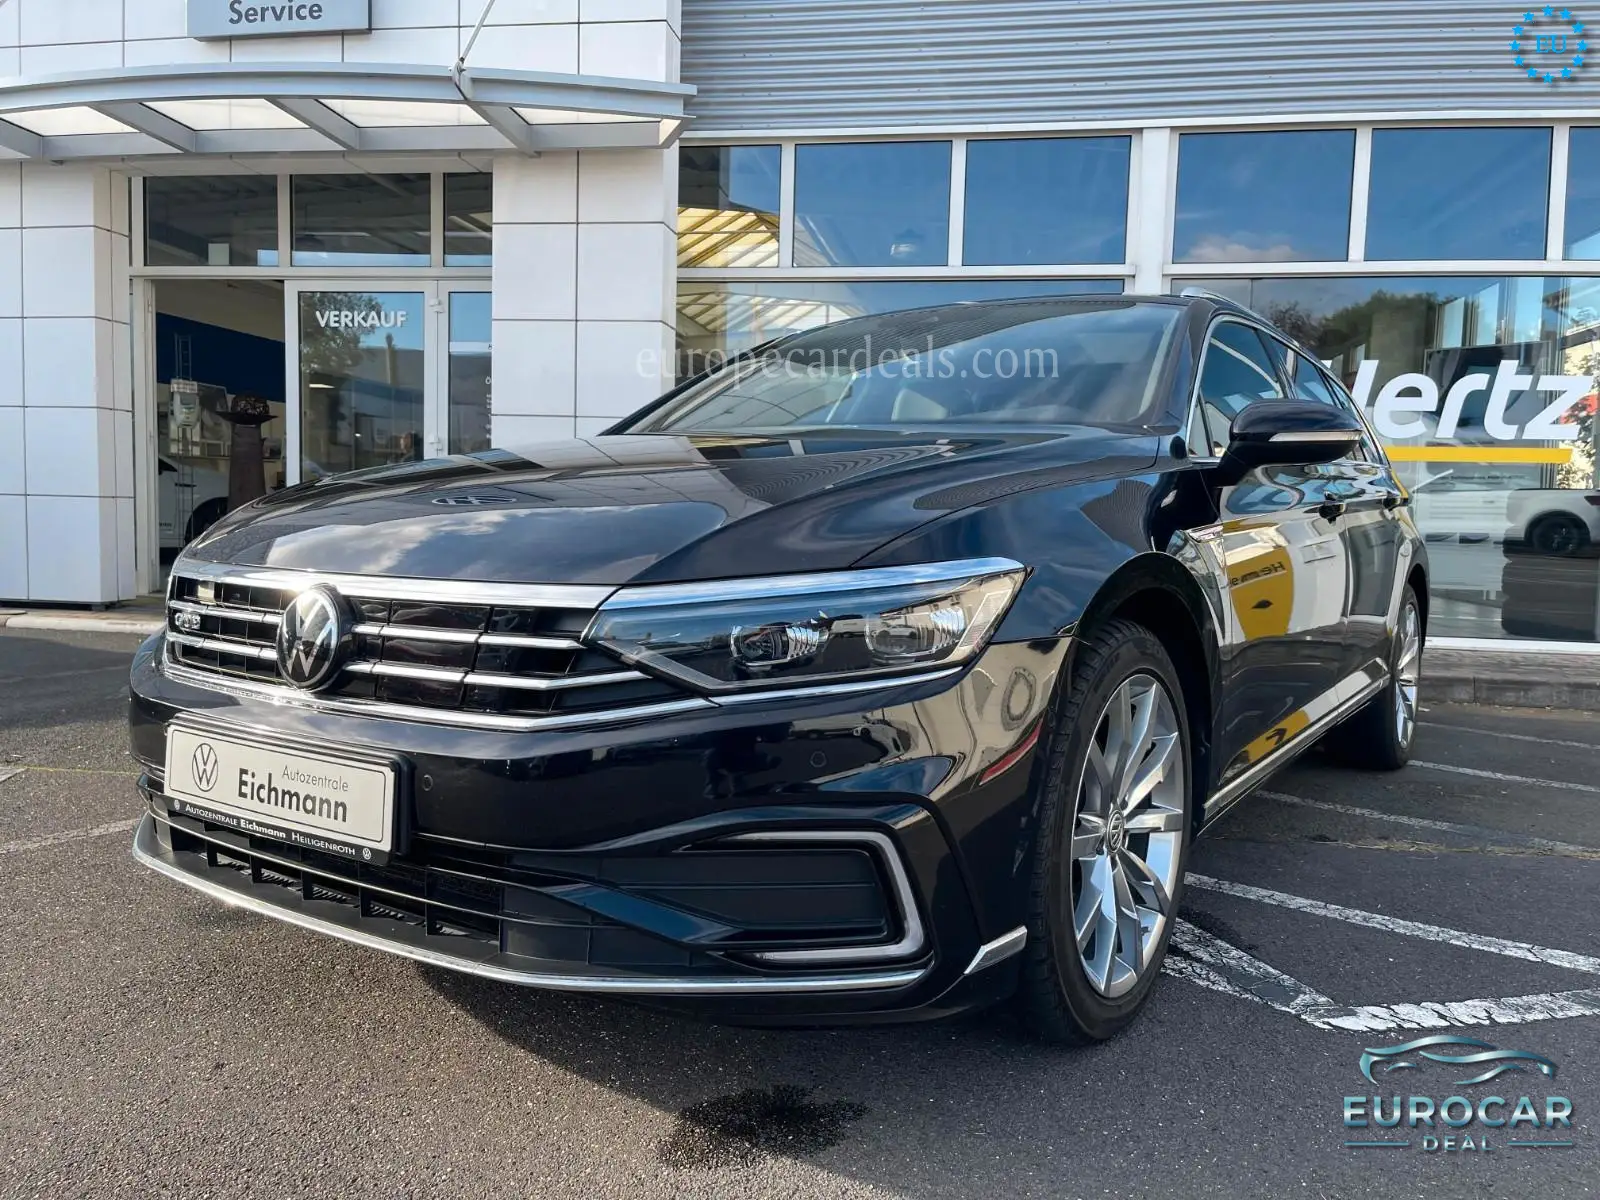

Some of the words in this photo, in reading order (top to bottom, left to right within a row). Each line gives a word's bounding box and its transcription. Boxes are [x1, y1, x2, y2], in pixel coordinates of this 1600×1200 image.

[228, 0, 323, 25] Service
[315, 310, 407, 328] VERKAUF
[281, 764, 350, 793] Autozentrale
[237, 767, 348, 823] Eichmann
[184, 804, 239, 827] AUTOZENTRALE
[240, 818, 286, 840] Eichmann
[291, 831, 356, 857] HEILIGENROTH
